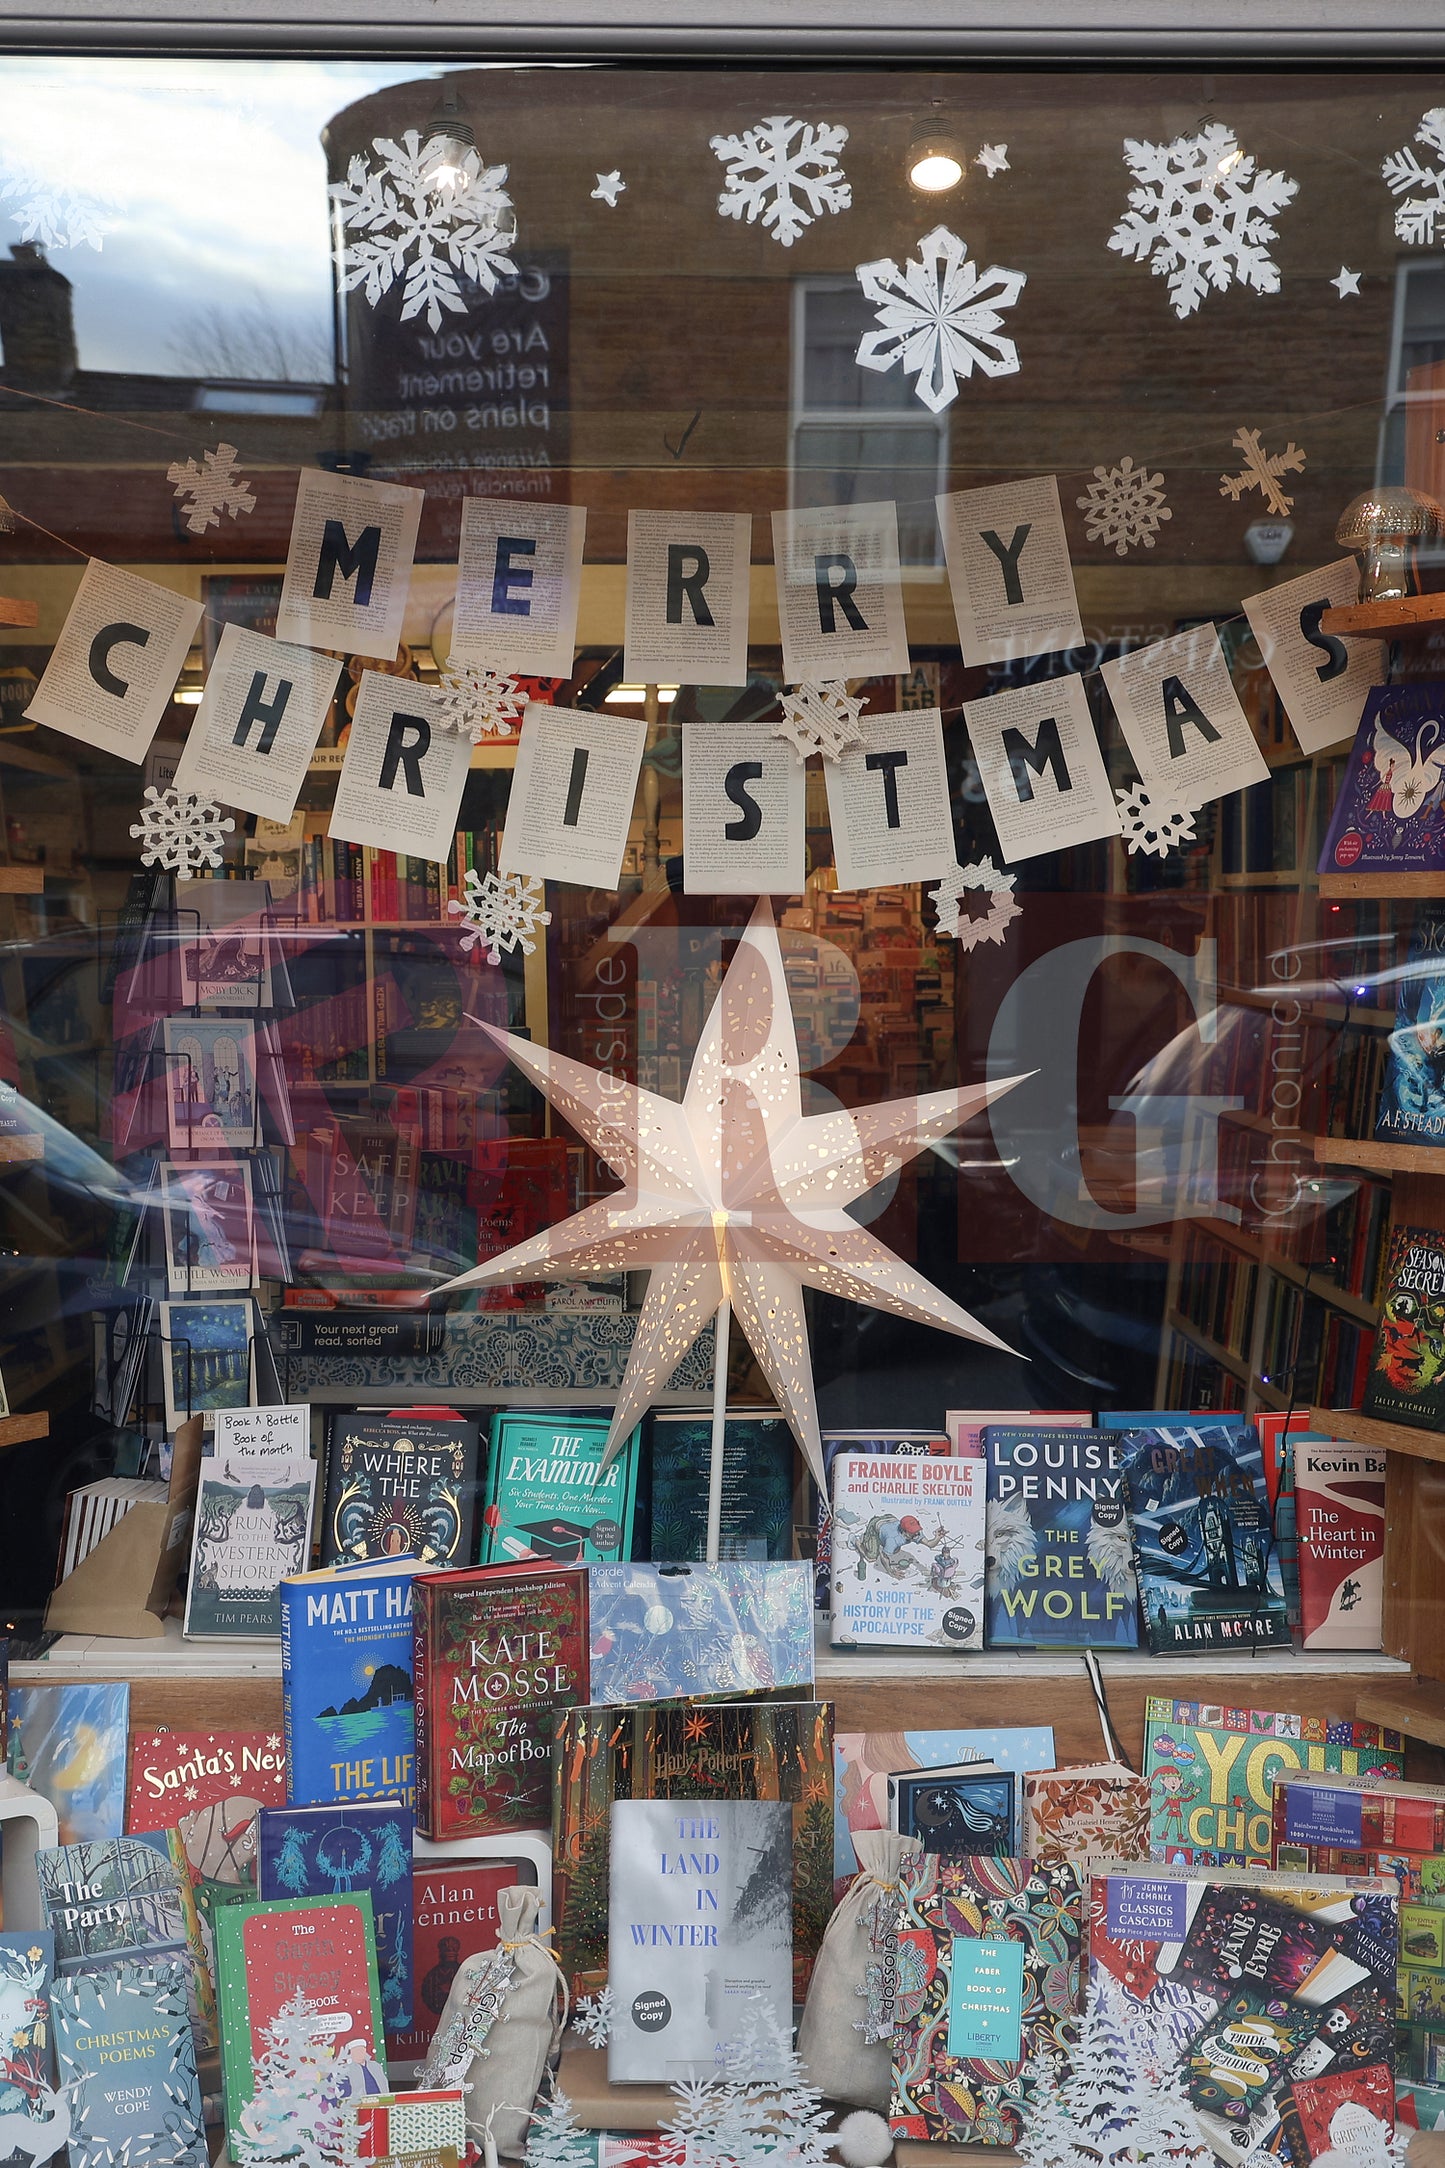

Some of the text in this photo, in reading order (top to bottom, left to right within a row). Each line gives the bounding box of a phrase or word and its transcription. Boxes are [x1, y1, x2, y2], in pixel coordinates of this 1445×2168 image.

[313, 519, 1033, 634] MERRY
[88, 599, 1348, 841] CHRISTMAS
[159, 766, 175, 779] Lite
[199, 985, 255, 996] MOBY DICK
[334, 1153, 412, 1178] SAFE
[330, 1191, 410, 1217] KEEP
[480, 1216, 514, 1228] Poems
[479, 1230, 493, 1240] for
[314, 1323, 399, 1337] Your next great
[314, 1336, 382, 1347] read, sorted
[224, 1413, 300, 1430] Book Bottle
[232, 1432, 257, 1446] Book
[549, 1435, 584, 1458] THE
[363, 1453, 442, 1476] WHERE
[994, 1442, 1120, 1470] LOUISE
[848, 1461, 974, 1483] FRANKIE BOYLE
[1307, 1457, 1360, 1473] Kevin
[379, 1477, 421, 1498] THE
[508, 1487, 579, 1501] Six One
[848, 1481, 973, 1497] and CHARLIE SKELTON
[999, 1474, 1122, 1501] PENNY
[514, 1499, 581, 1513] Your Time Starts
[1094, 1502, 1120, 1513] Signed
[235, 1516, 273, 1531] RUN
[1097, 1511, 1118, 1521] Copy
[1308, 1508, 1339, 1524] The
[237, 1533, 269, 1542] TO THE
[595, 1525, 616, 1534] Signed
[1044, 1529, 1079, 1543] THE
[1310, 1526, 1376, 1542] Heart in
[211, 1545, 291, 1561] WESTERN
[1310, 1544, 1367, 1559] Winter
[220, 1564, 278, 1580] SHORE
[591, 1566, 624, 1577] Borde
[1017, 1553, 1109, 1580] GREY
[1133, 1552, 1144, 1584] ALAN
[453, 1582, 566, 1600] Signed Independent Bookshop Edition
[864, 1590, 913, 1605] A SHORT
[306, 1588, 379, 1627] MATT
[842, 1604, 935, 1621] HISTORY OF THE
[1001, 1587, 1127, 1621] WOLF
[214, 1612, 273, 1624] TIM PEARS
[946, 1610, 975, 1625] Signed
[851, 1620, 926, 1636] APOCALYPSE
[947, 1619, 969, 1634] Copy
[1174, 1621, 1215, 1641] ALAN
[280, 1602, 292, 1671] MATT HAIG
[470, 1631, 557, 1668] KATE
[415, 1636, 425, 1748] KATE MOSSE
[452, 1664, 572, 1706] MOSSE
[284, 1693, 292, 1737] THE LIFE
[495, 1717, 527, 1739] The
[451, 1743, 517, 1776] Map of
[654, 1747, 740, 1780] Harry Potter
[142, 1747, 234, 1799] Santa's
[330, 1758, 376, 1792] THE
[673, 1816, 721, 1840] THE
[1099, 1818, 1123, 1828] Hemery
[1293, 1821, 1355, 1835] Rainbow Bookshelves
[659, 1853, 721, 1875] LAND
[58, 1880, 104, 1906] The
[420, 1884, 475, 1905] Alan
[1141, 1883, 1169, 1893] JENNY
[695, 1888, 719, 1911] IN
[1136, 1892, 1173, 1902] ZEMANEK
[63, 1899, 128, 1932] Party
[412, 1905, 496, 1928] ennett
[1119, 1903, 1174, 1916] CLASSICS
[291, 1924, 316, 1936] The
[1119, 1915, 1174, 1928] CASCADE
[629, 1924, 719, 1948] WINTER
[1110, 1927, 1126, 1935] 1000
[275, 1938, 335, 1961] Gavin
[980, 1948, 998, 1957] THE
[974, 1966, 1001, 1976] FABER
[1355, 1946, 1393, 1979] VENICE
[879, 1933, 899, 2011] Glossop
[1411, 1973, 1433, 1986] PLAY
[273, 1969, 342, 1994] Stacey
[966, 1984, 1007, 1995] BOOK OF
[633, 1998, 667, 2013] Signed
[961, 2002, 1010, 2014] CHRISTMAS
[640, 2008, 665, 2022] Copy
[449, 1992, 498, 2066] Glossop
[967, 2032, 1001, 2043] LIBERTY
[75, 2025, 171, 2051] CHRISTMAS
[1228, 2031, 1268, 2047] PRIDE
[99, 2044, 157, 2066] POEMS
[1203, 2043, 1264, 2075] PREJUDICE
[103, 2085, 153, 2105] WENDY
[114, 2100, 151, 2117] COPE
